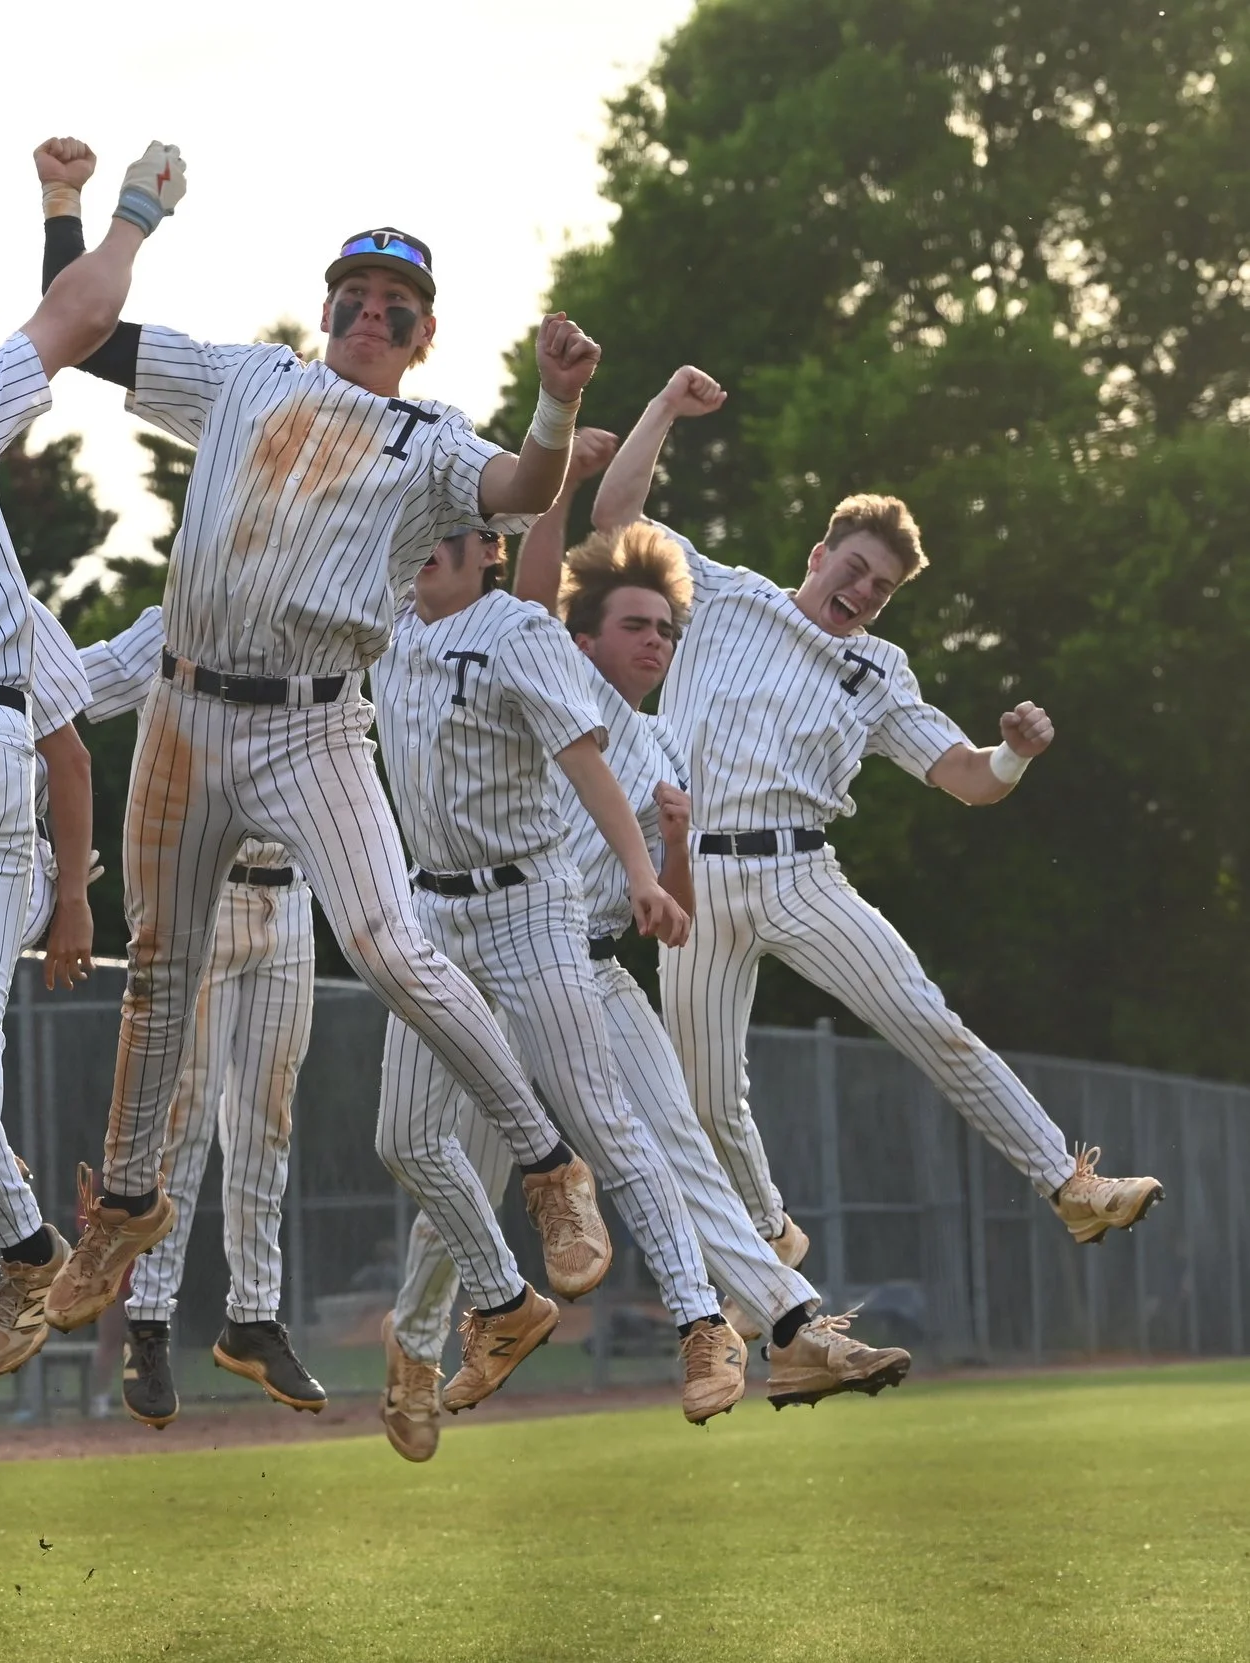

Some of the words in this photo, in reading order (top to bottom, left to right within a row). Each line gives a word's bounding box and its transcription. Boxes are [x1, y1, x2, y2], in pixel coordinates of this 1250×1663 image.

[382, 398, 441, 461] T
[443, 650, 489, 707] T
[840, 649, 886, 697] T
